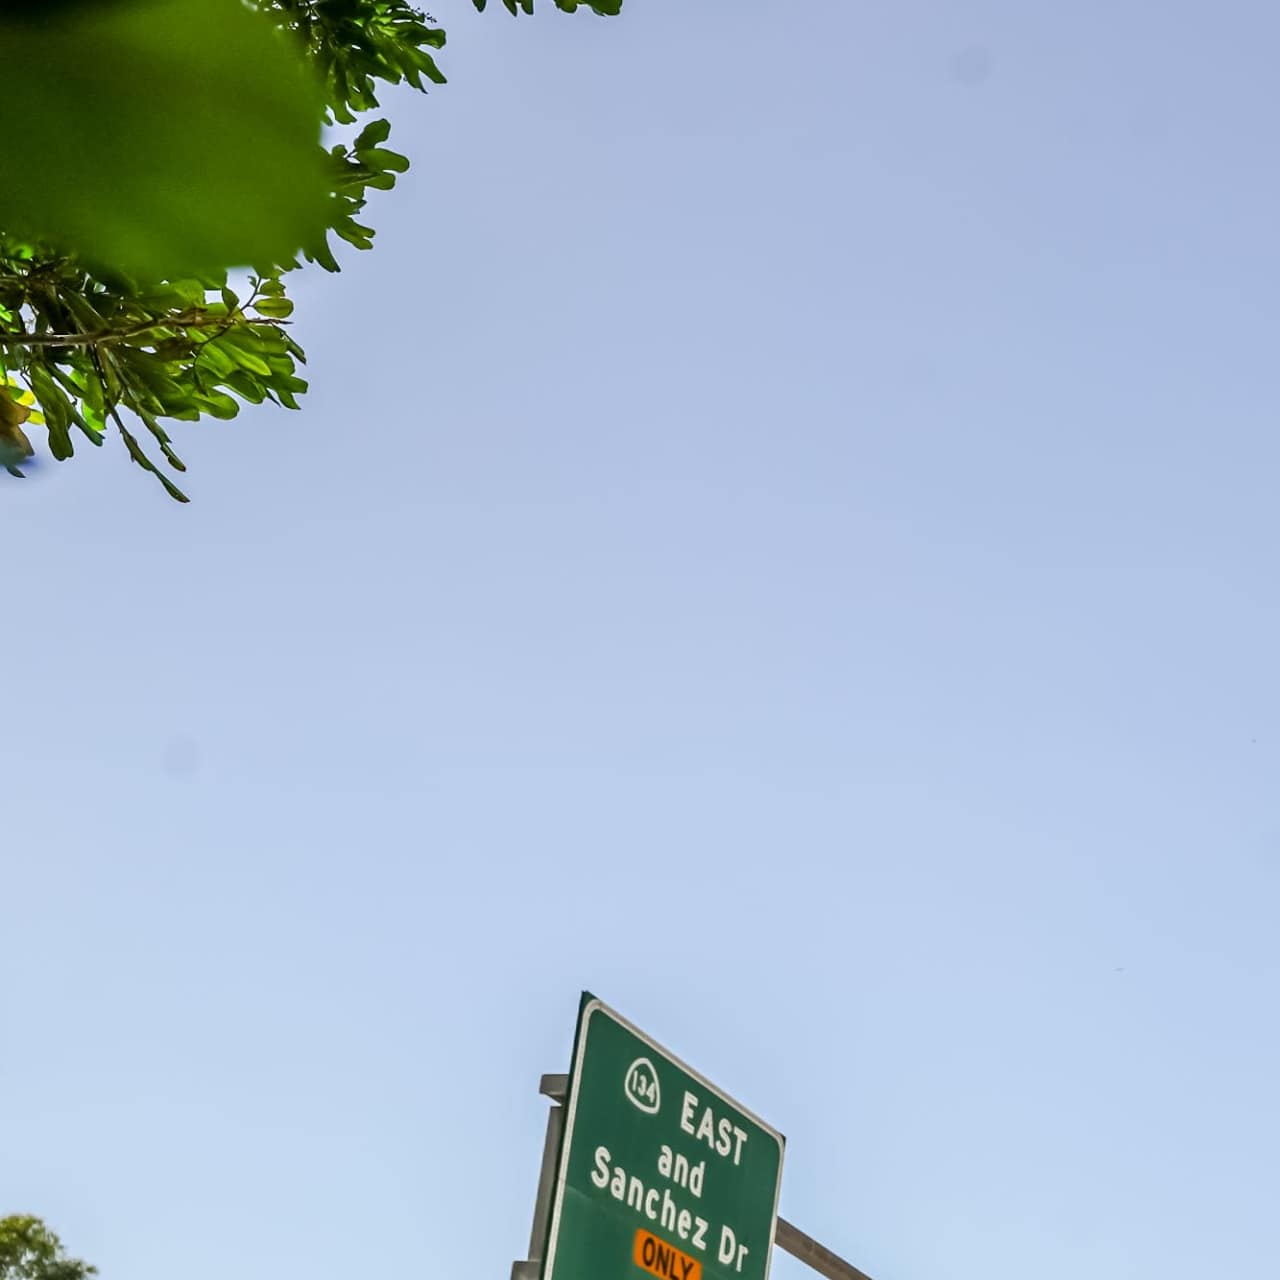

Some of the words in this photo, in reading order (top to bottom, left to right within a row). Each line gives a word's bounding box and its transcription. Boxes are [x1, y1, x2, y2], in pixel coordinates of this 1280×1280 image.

[632, 1070, 655, 1103] 134
[681, 1090, 748, 1166] EAST
[591, 1146, 709, 1251] Sanchez
[718, 1224, 749, 1272] Dr
[658, 1145, 705, 1198] and
